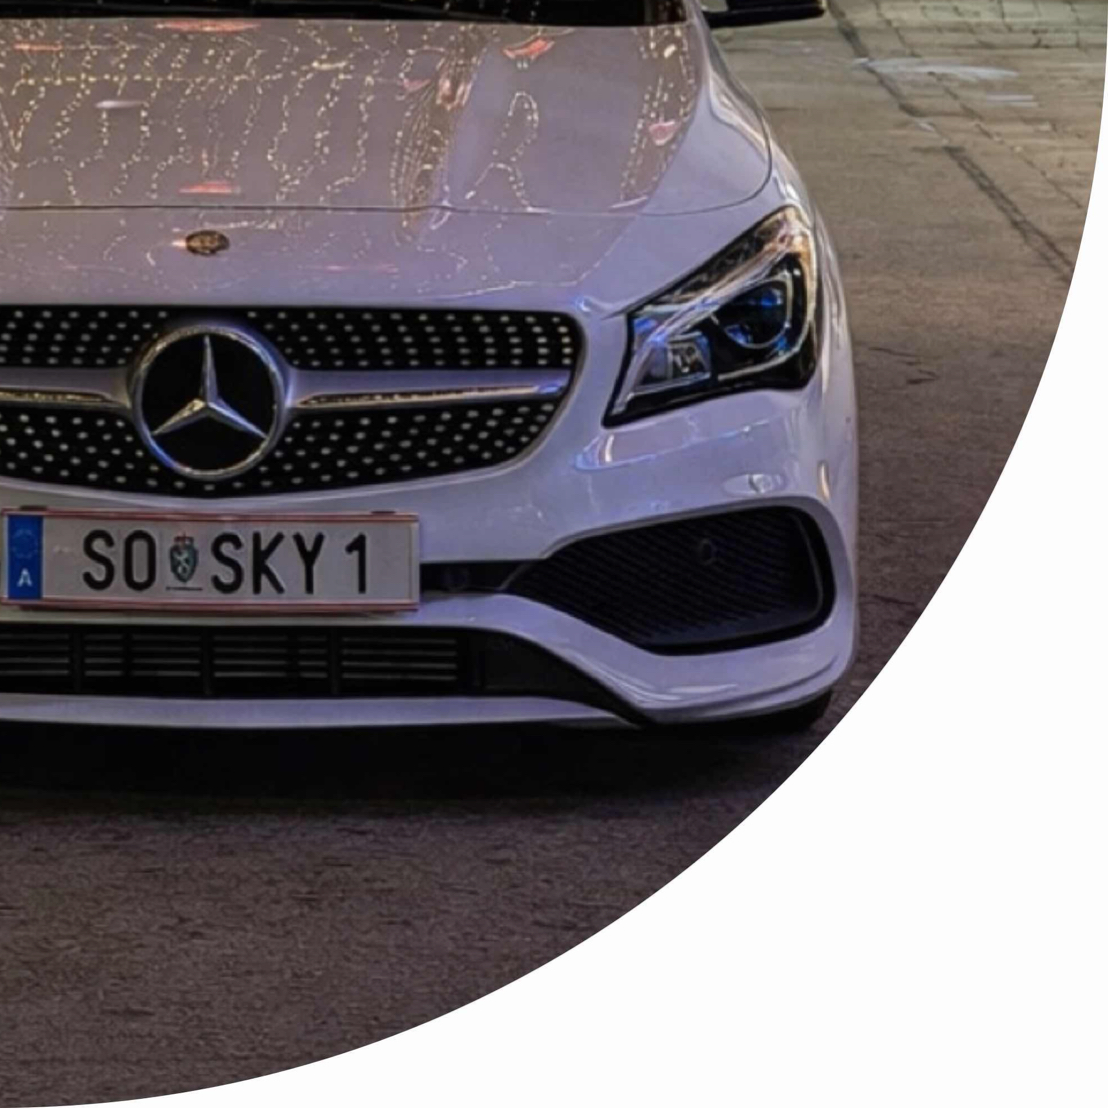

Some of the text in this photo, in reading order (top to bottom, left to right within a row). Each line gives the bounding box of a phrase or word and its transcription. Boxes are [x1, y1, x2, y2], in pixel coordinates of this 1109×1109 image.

[17, 568, 33, 587] A
[82, 529, 367, 595] SO SKY 1
